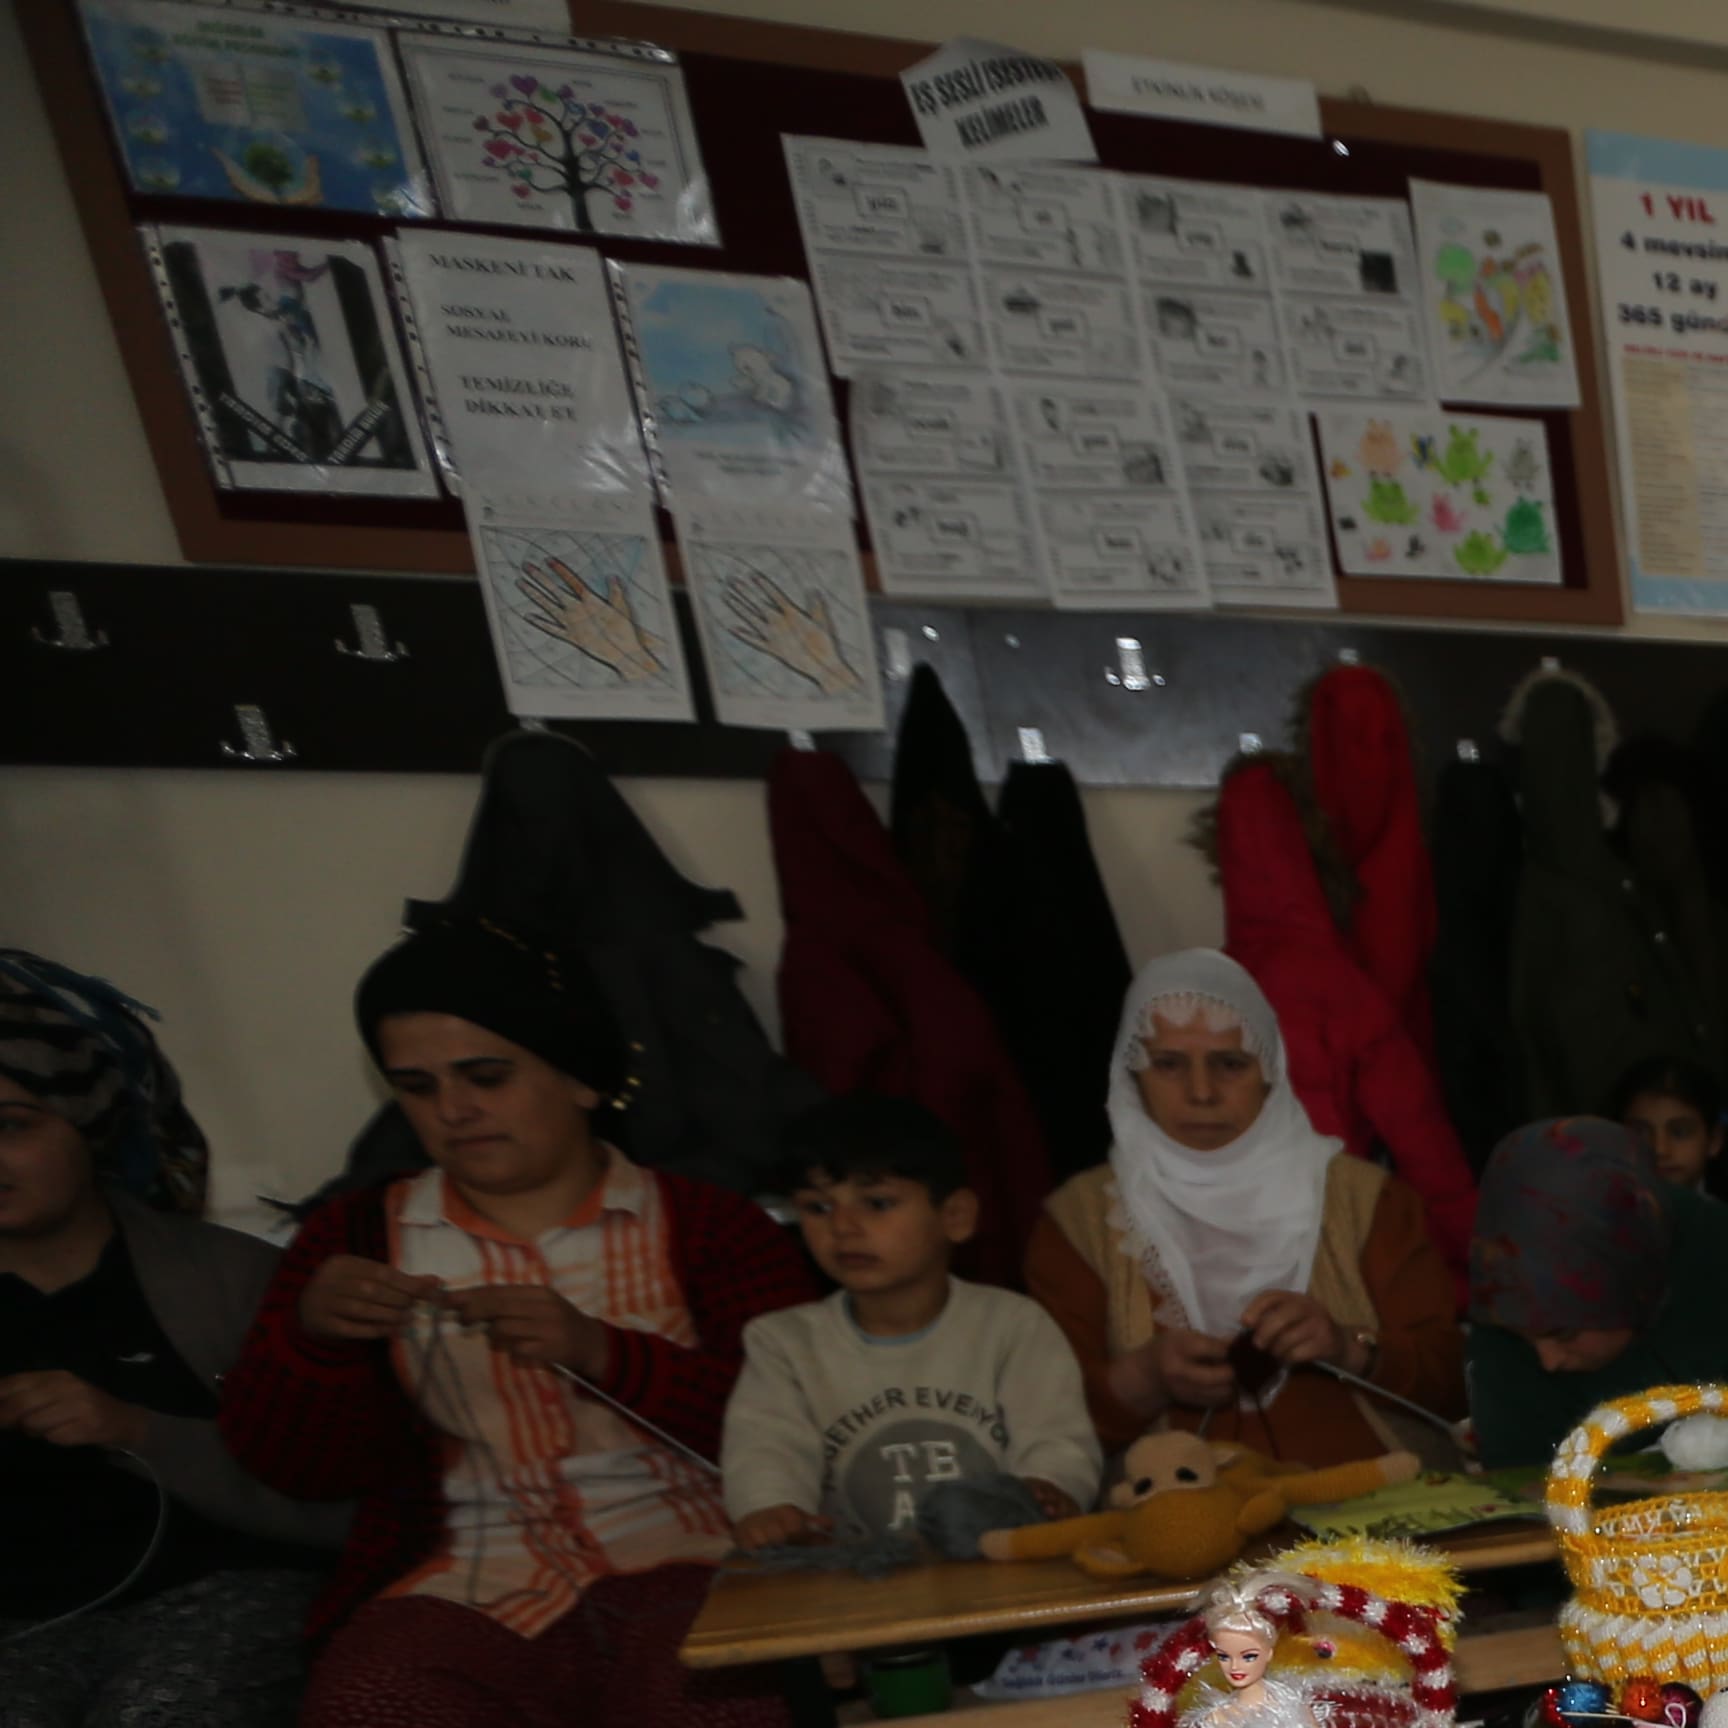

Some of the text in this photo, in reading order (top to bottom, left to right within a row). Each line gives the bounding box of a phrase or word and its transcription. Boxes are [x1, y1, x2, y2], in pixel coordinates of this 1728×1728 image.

[1640, 192, 1717, 225] 1 YIL
[1621, 230, 1636, 251] 4
[428, 253, 577, 284] MASKENİ TAK
[1653, 271, 1718, 301] 12 ay
[440, 304, 512, 323] SOSYAL
[1617, 302, 1662, 327] 365
[821, 1386, 907, 1491] TGETHER
